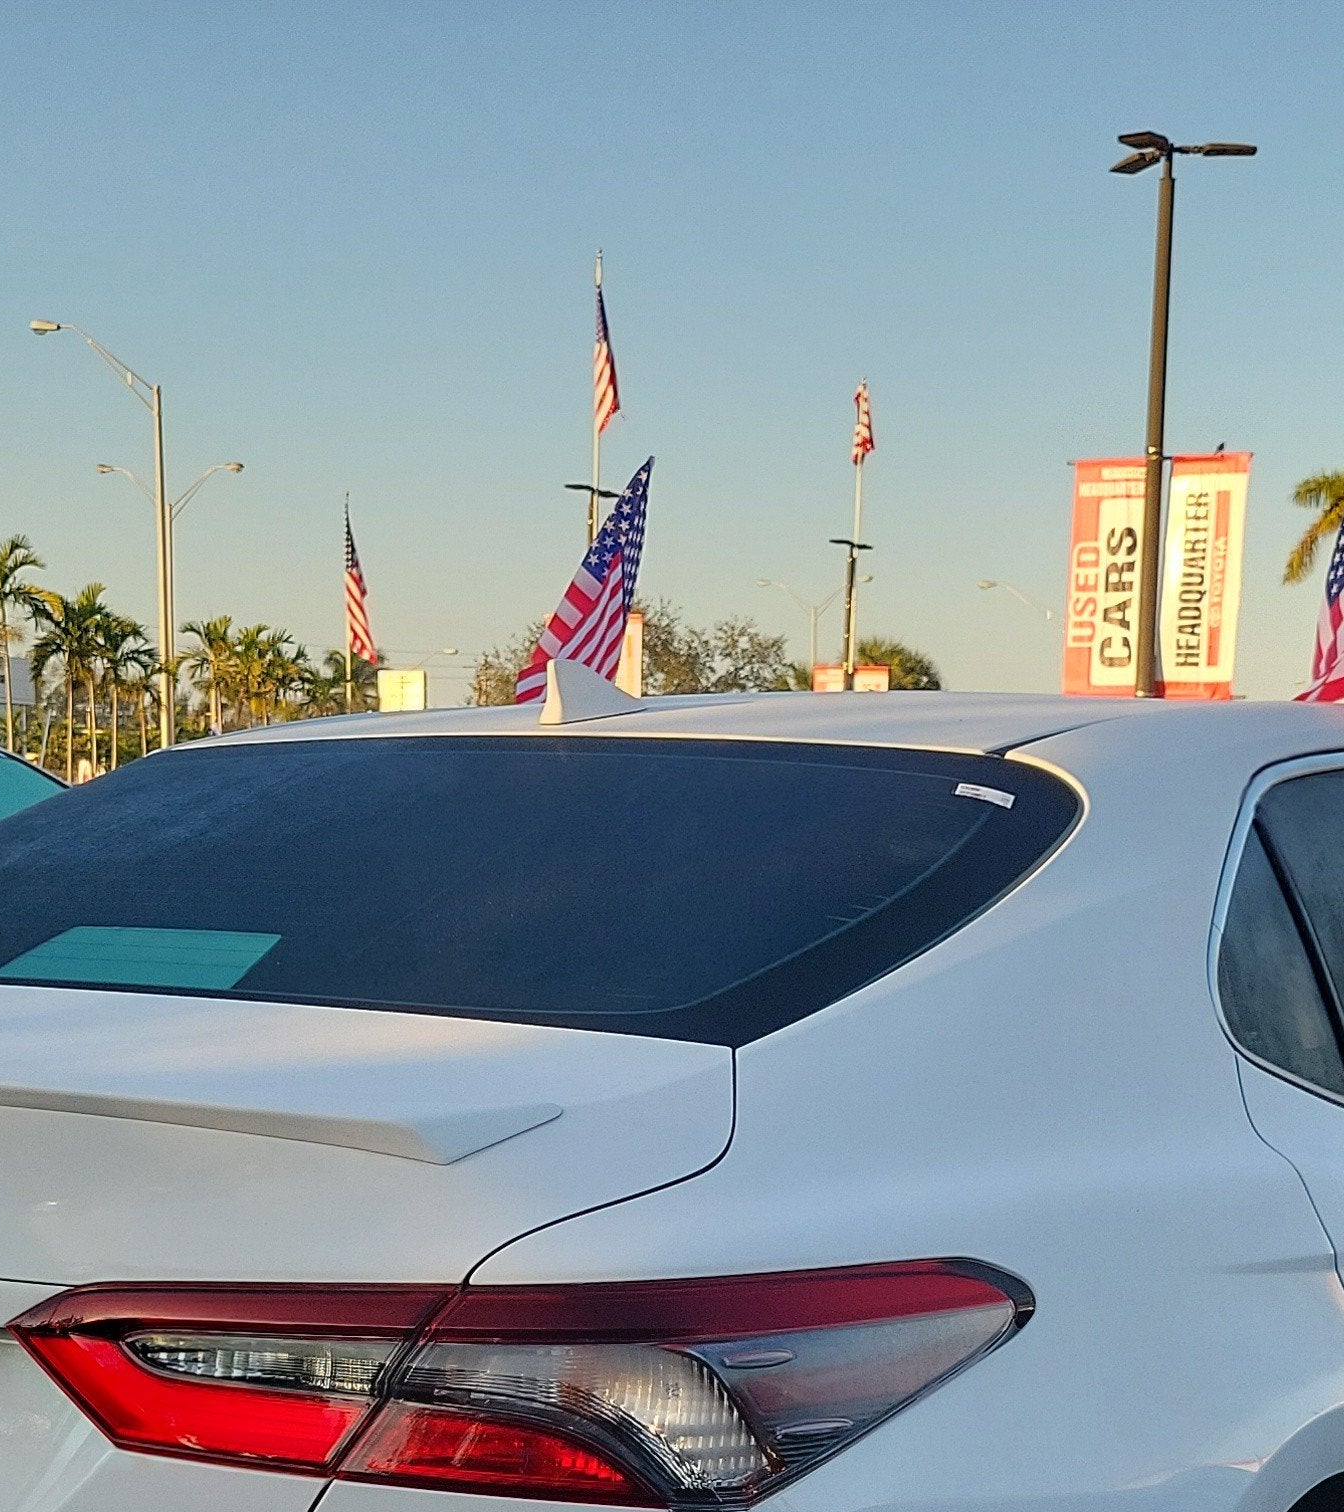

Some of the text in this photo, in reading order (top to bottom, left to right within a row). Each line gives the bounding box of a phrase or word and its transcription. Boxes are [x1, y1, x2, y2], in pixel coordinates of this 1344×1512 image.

[1071, 545, 1100, 643] USED
[1099, 526, 1138, 668] CARS
[1175, 491, 1210, 667] HEADQUARTER
[1209, 536, 1227, 602] TOYOTA
